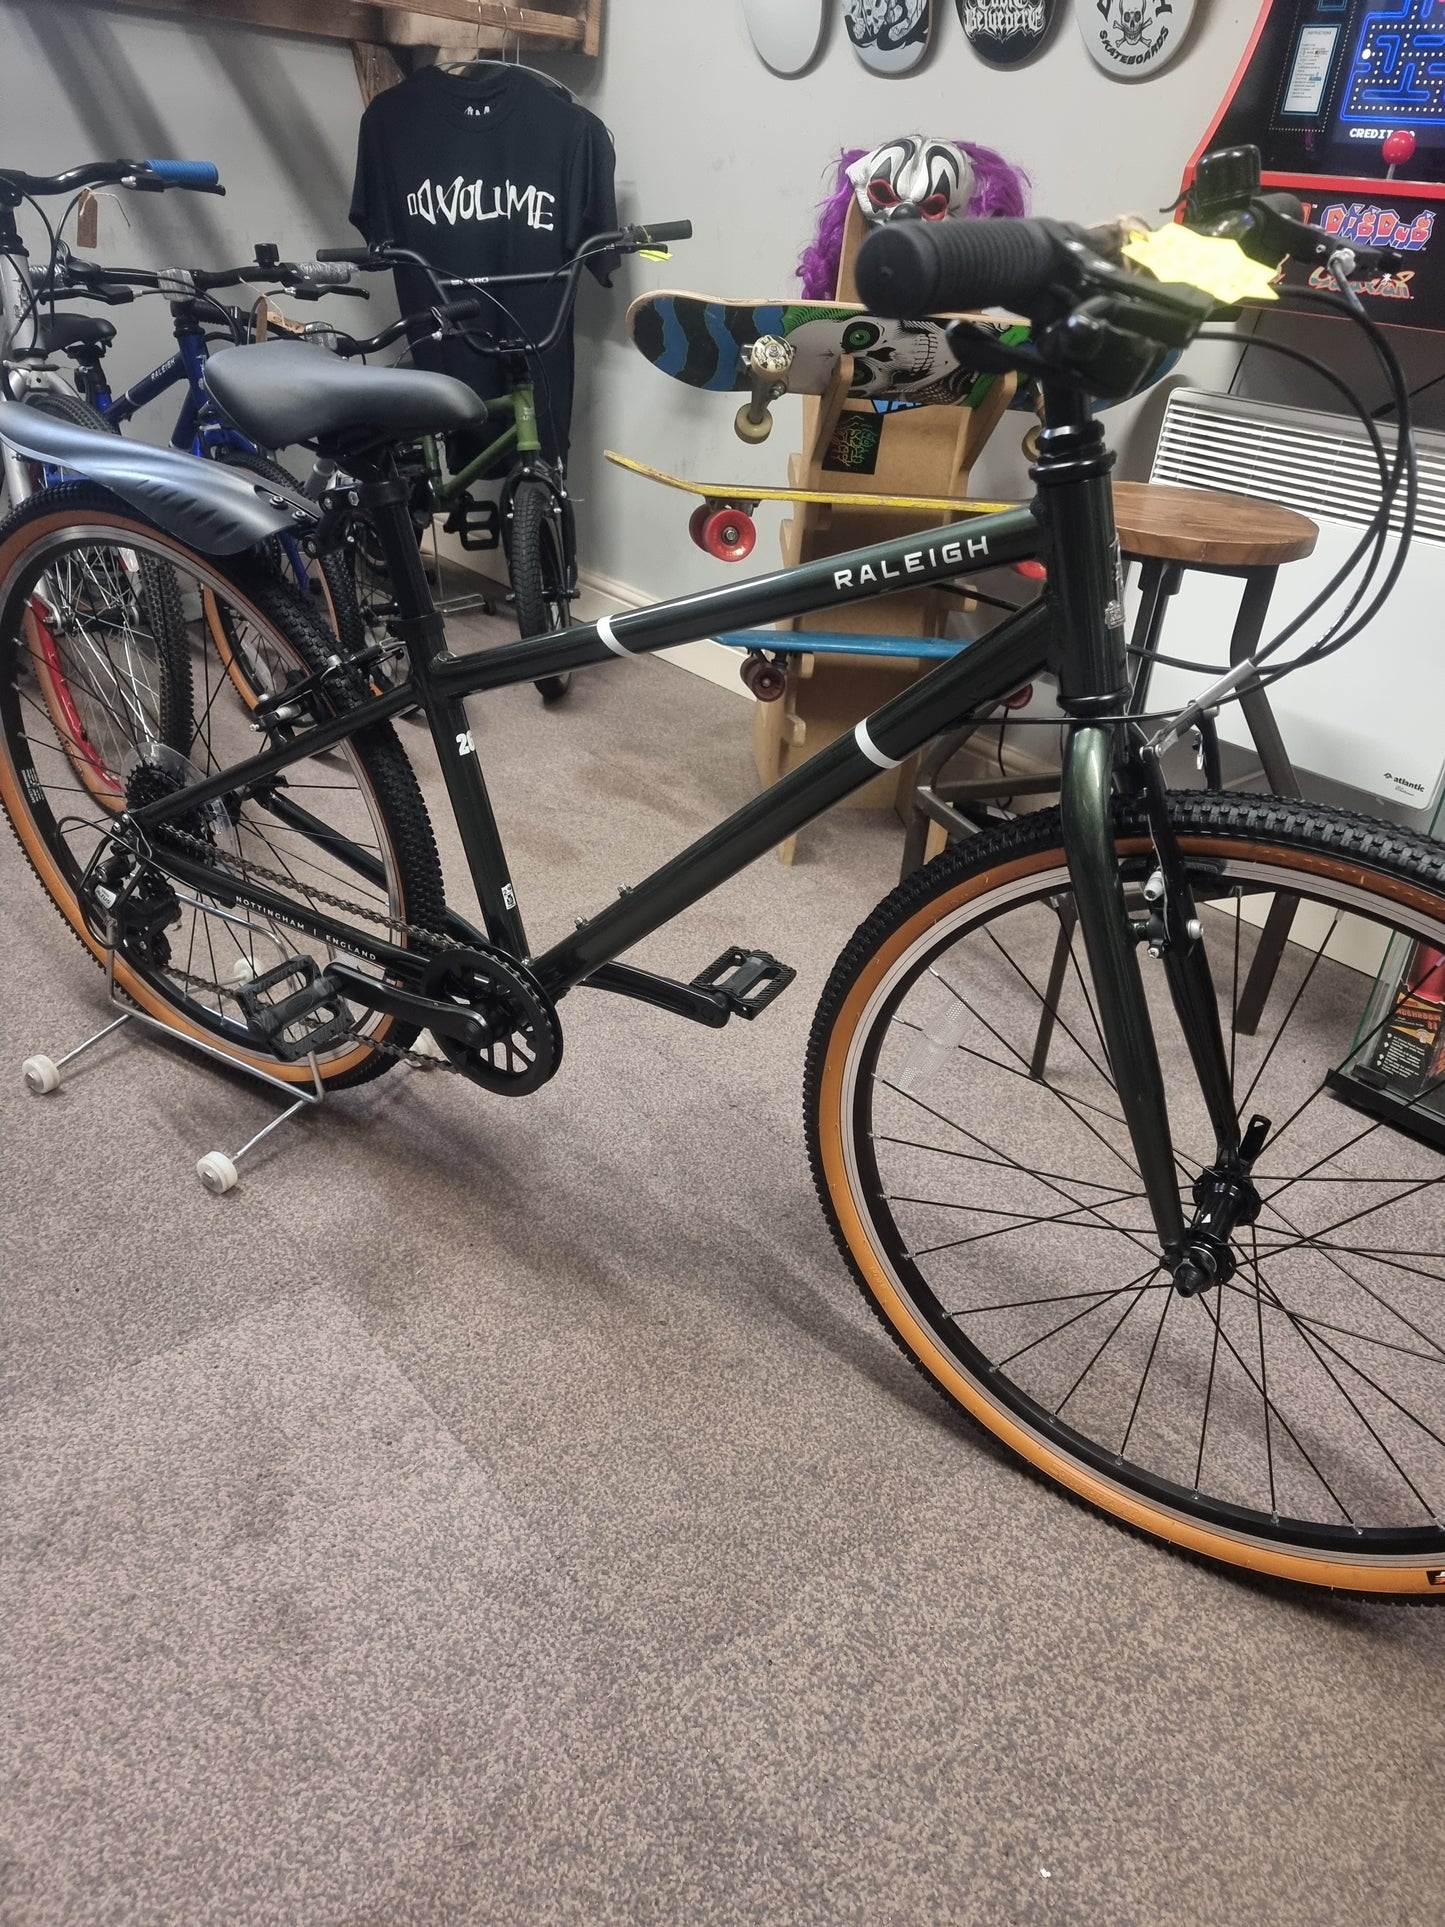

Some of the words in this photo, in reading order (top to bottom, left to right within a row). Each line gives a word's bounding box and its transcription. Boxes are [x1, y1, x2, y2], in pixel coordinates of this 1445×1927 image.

[1099, 26, 1169, 65] SKATEBOARDS
[151, 357, 175, 381] RALEIGH
[833, 535, 989, 590] RALEIGH
[1393, 776, 1425, 793] atlantic
[235, 895, 305, 930] NOTTINGHAM
[325, 934, 376, 960] ENGLAND
